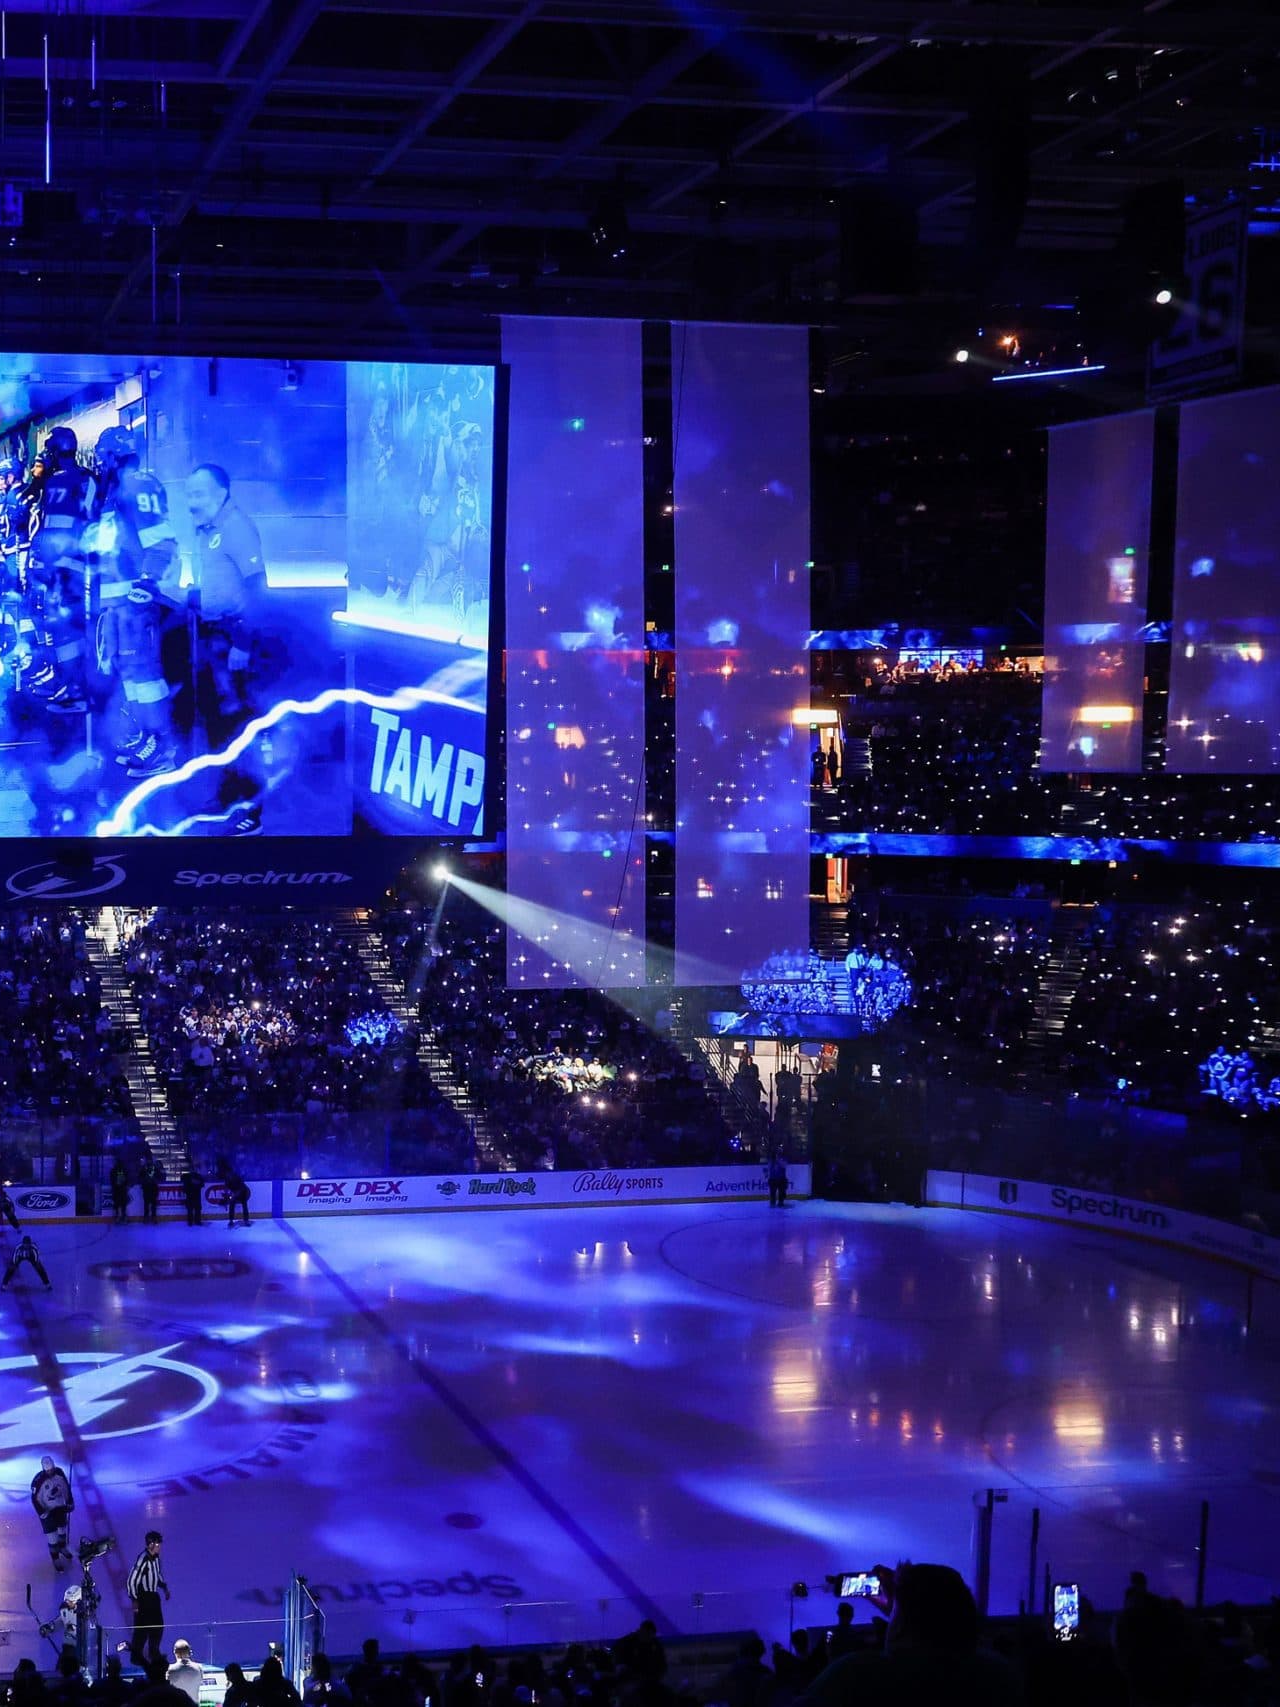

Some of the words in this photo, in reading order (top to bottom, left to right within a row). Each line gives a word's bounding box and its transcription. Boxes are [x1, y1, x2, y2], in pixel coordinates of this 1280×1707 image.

[136, 492, 161, 514] 91
[173, 870, 348, 888] Spectrum
[297, 1182, 347, 1198] DEX
[354, 1180, 404, 1196] DEX
[468, 1178, 503, 1195] Hard
[503, 1176, 537, 1196] Rock
[573, 1171, 626, 1196] Bally
[626, 1176, 664, 1191] SPORTS
[26, 1193, 62, 1210] Ford
[309, 1195, 352, 1205] imaging
[366, 1193, 409, 1203] imaging
[1051, 1188, 1168, 1229] Spectrum
